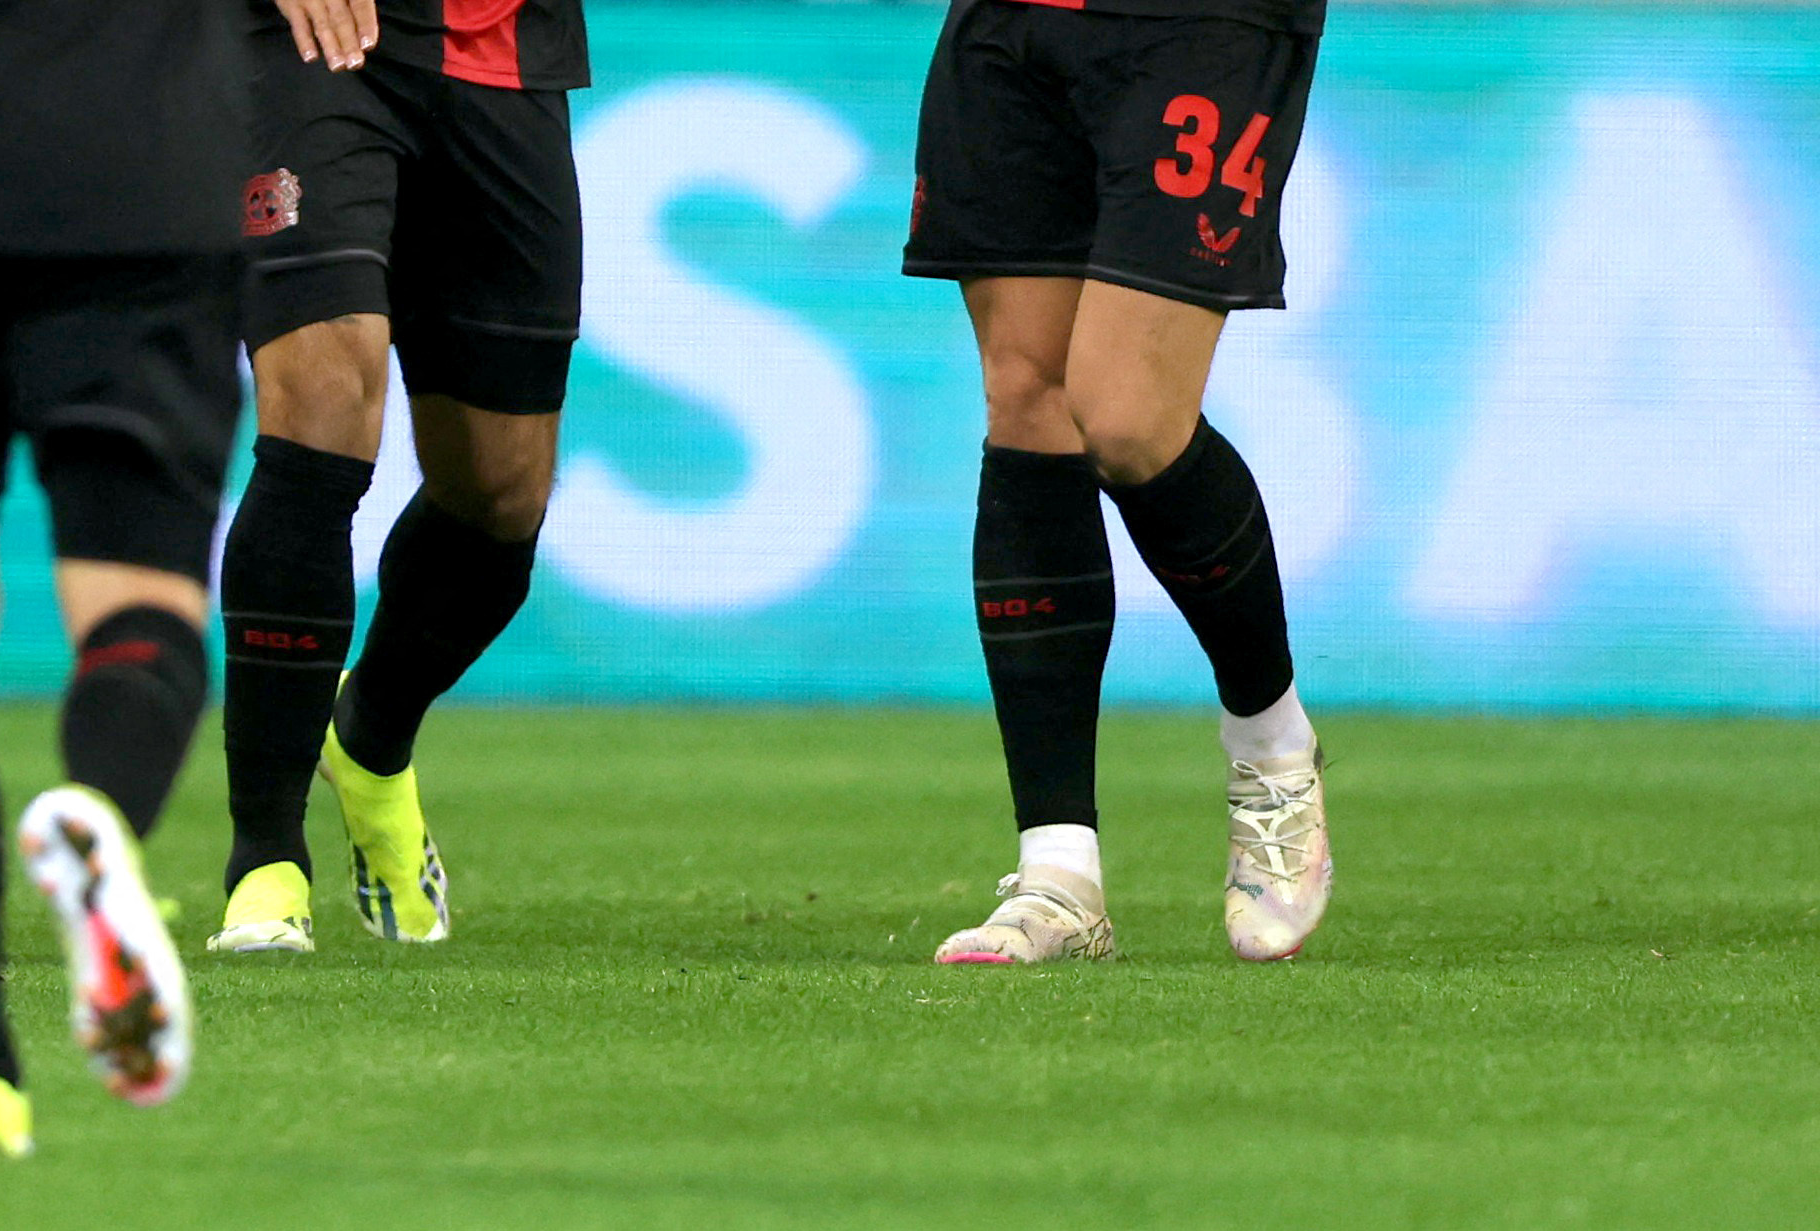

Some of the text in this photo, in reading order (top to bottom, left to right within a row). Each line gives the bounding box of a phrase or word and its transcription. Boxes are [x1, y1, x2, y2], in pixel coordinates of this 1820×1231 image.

[1154, 93, 1271, 218] 34
[983, 597, 1057, 618] B04
[243, 629, 320, 650] B04
